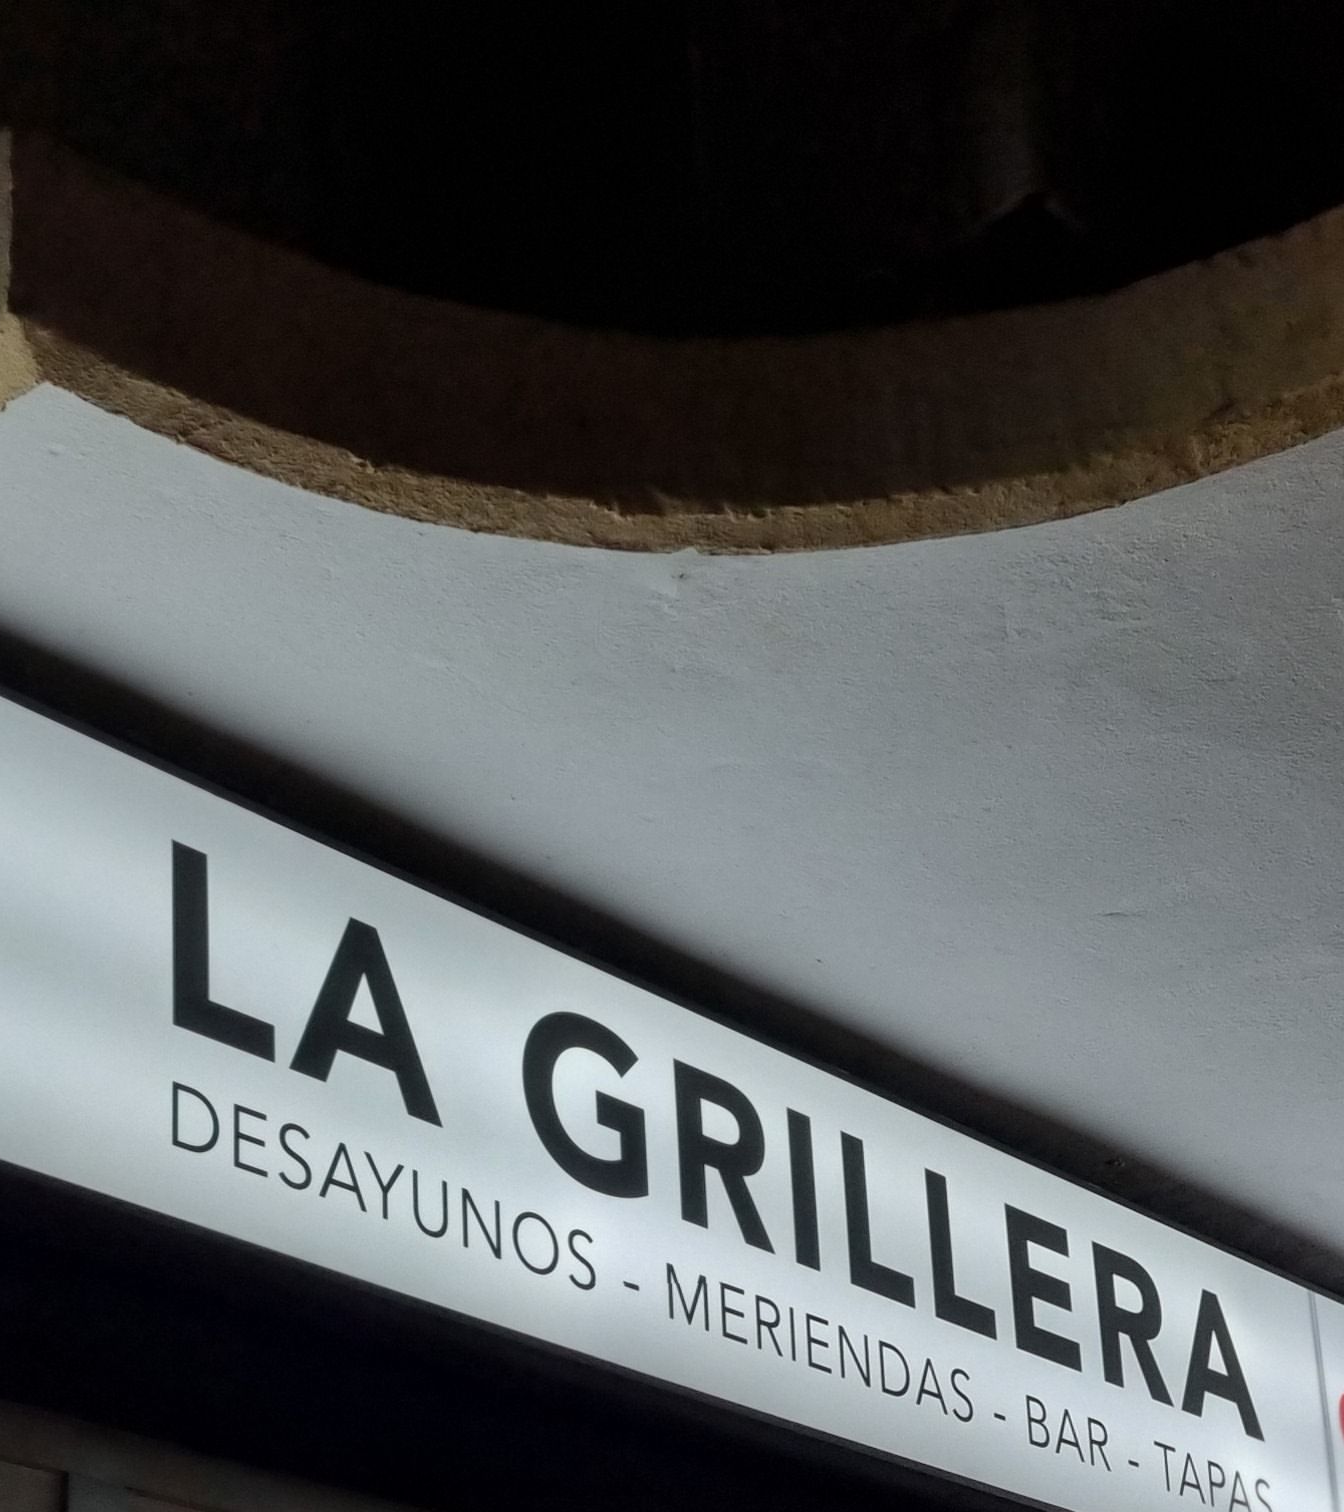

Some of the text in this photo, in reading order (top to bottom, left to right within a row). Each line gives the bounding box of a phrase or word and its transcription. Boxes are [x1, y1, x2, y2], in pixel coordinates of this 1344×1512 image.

[171, 838, 1266, 1441] LA GRILLERA
[171, 1081, 599, 1293] DESAYUNOS
[666, 1262, 975, 1424] MERIENDAS
[1024, 1394, 1111, 1473] BAR
